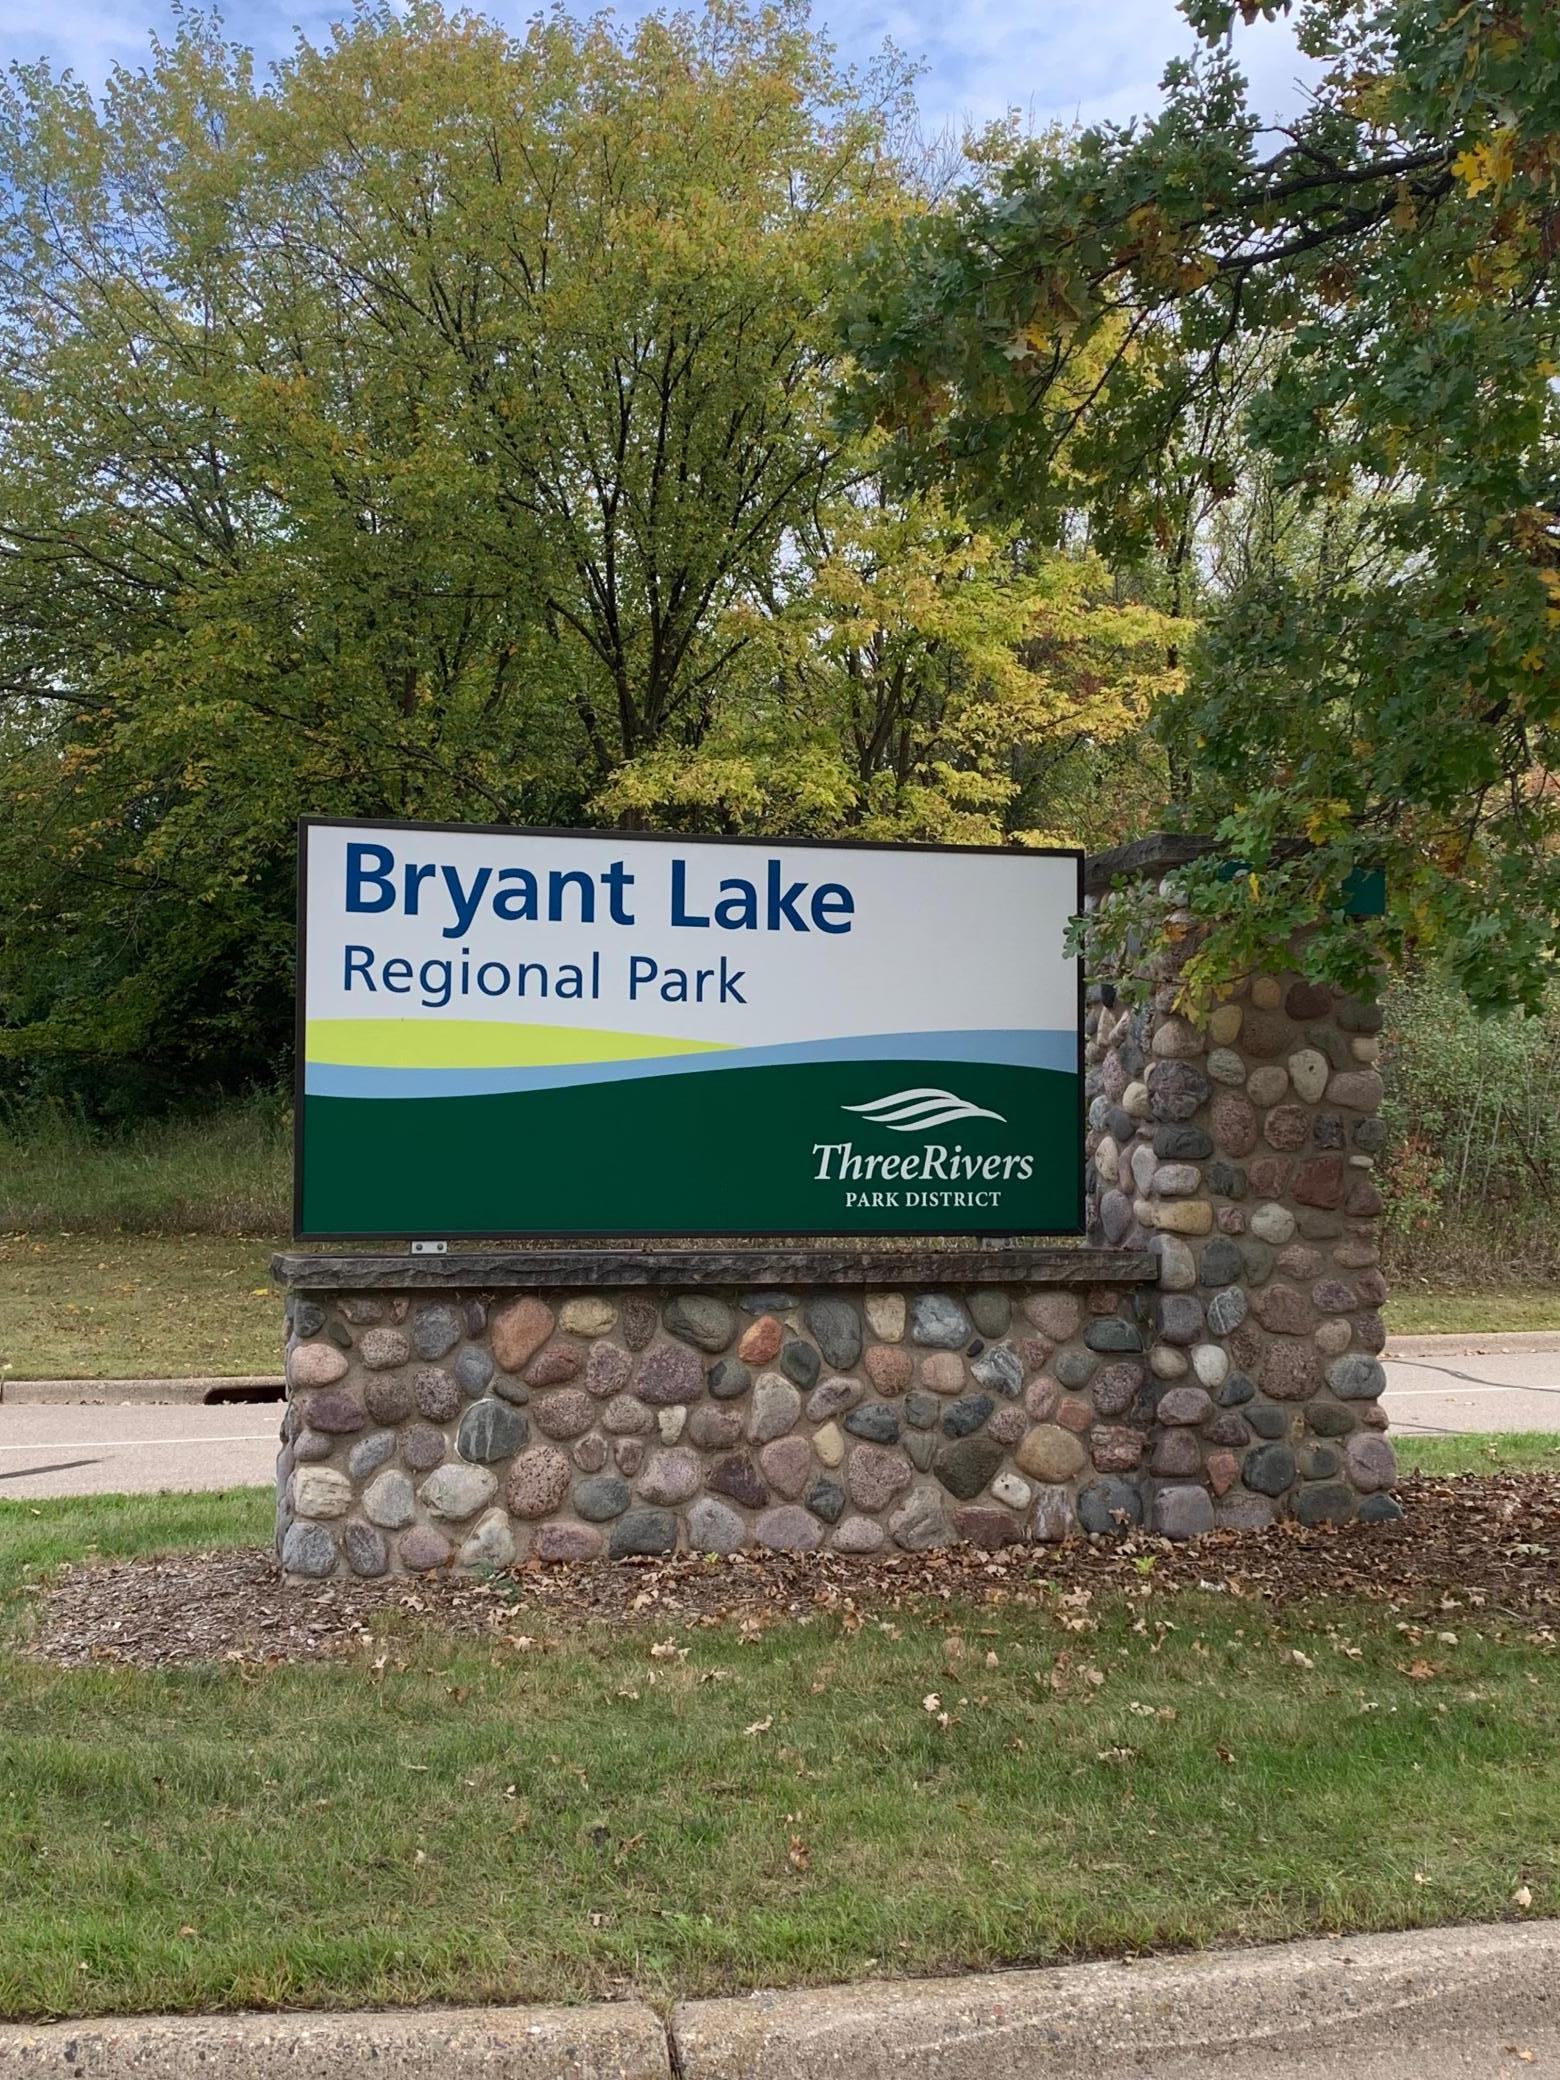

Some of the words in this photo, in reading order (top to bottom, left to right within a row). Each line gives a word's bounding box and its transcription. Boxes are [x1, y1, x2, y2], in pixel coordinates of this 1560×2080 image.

[345, 842, 636, 940] Bryant
[670, 859, 855, 935] Lake
[343, 944, 600, 1008] Regional
[629, 955, 748, 1004] Park
[845, 1191, 899, 1207] PARK
[905, 1191, 1002, 1207] DISTRICT
